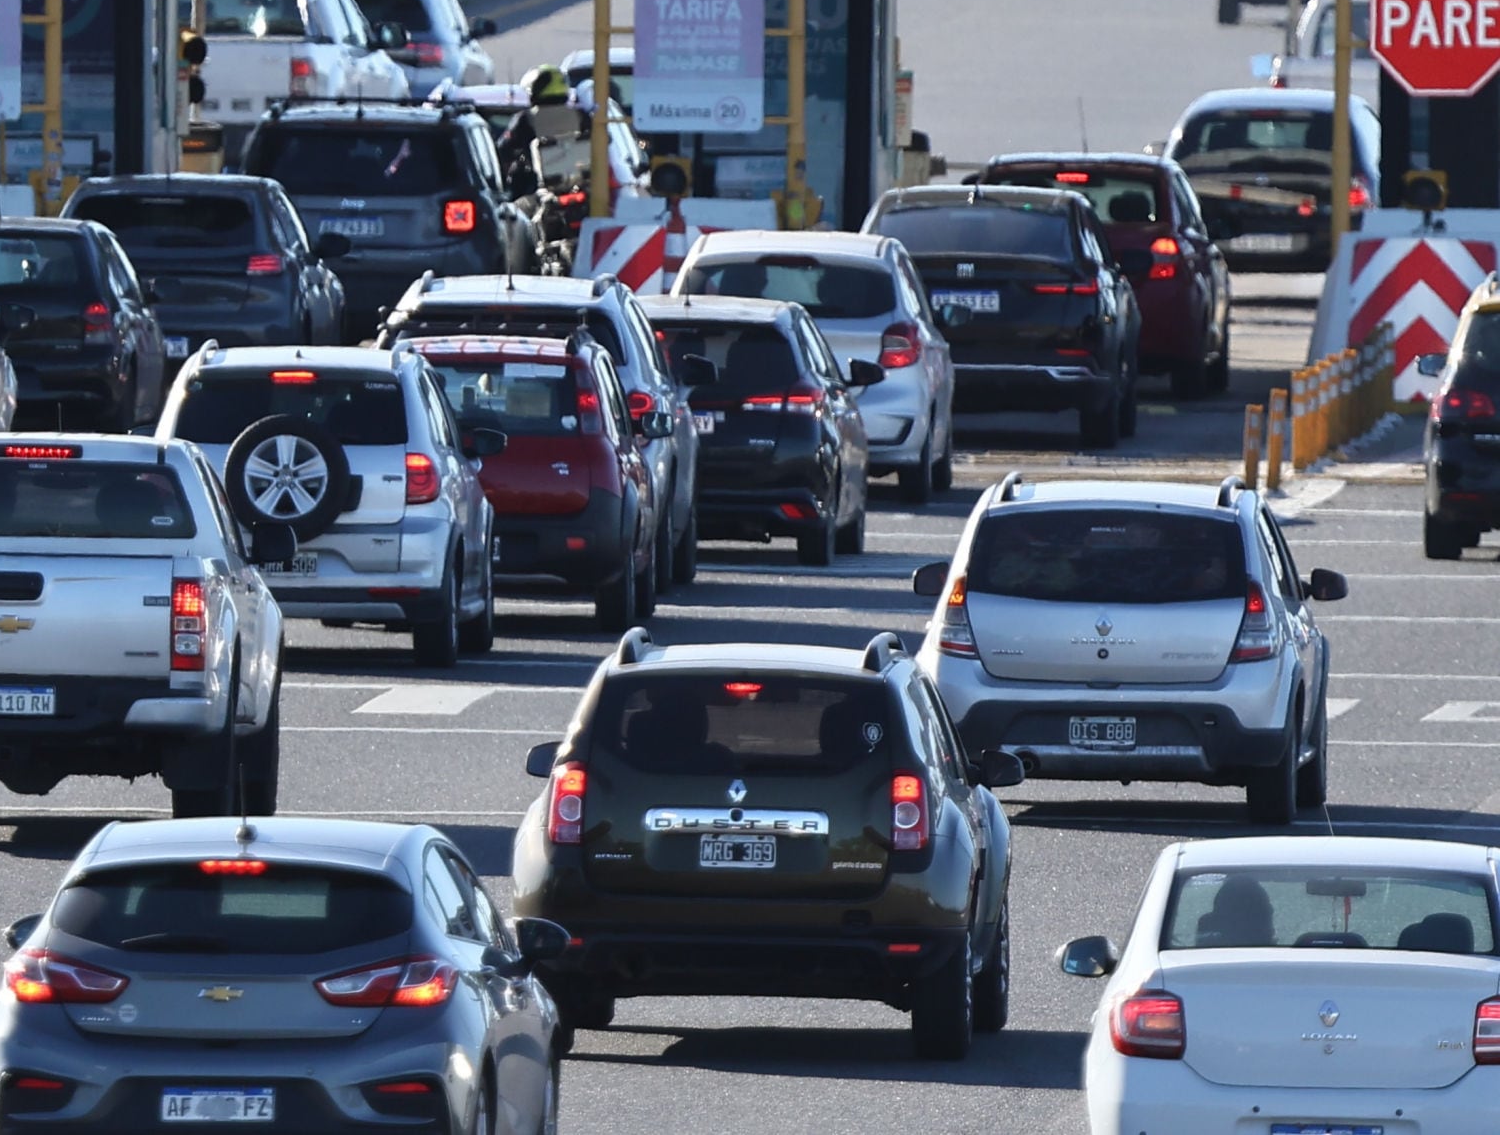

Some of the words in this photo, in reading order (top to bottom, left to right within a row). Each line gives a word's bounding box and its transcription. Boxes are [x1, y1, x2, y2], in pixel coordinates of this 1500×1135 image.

[654, 0, 743, 20] TARIFA
[650, 103, 712, 118] Máxima
[720, 104, 741, 118] 20
[654, 817, 820, 832] DUSTER
[703, 842, 733, 861] MRG
[742, 843, 773, 862] 369
[1301, 1032, 1358, 1041] LOGAN
[167, 1096, 192, 1117] AF
[243, 1096, 269, 1117] FZ
